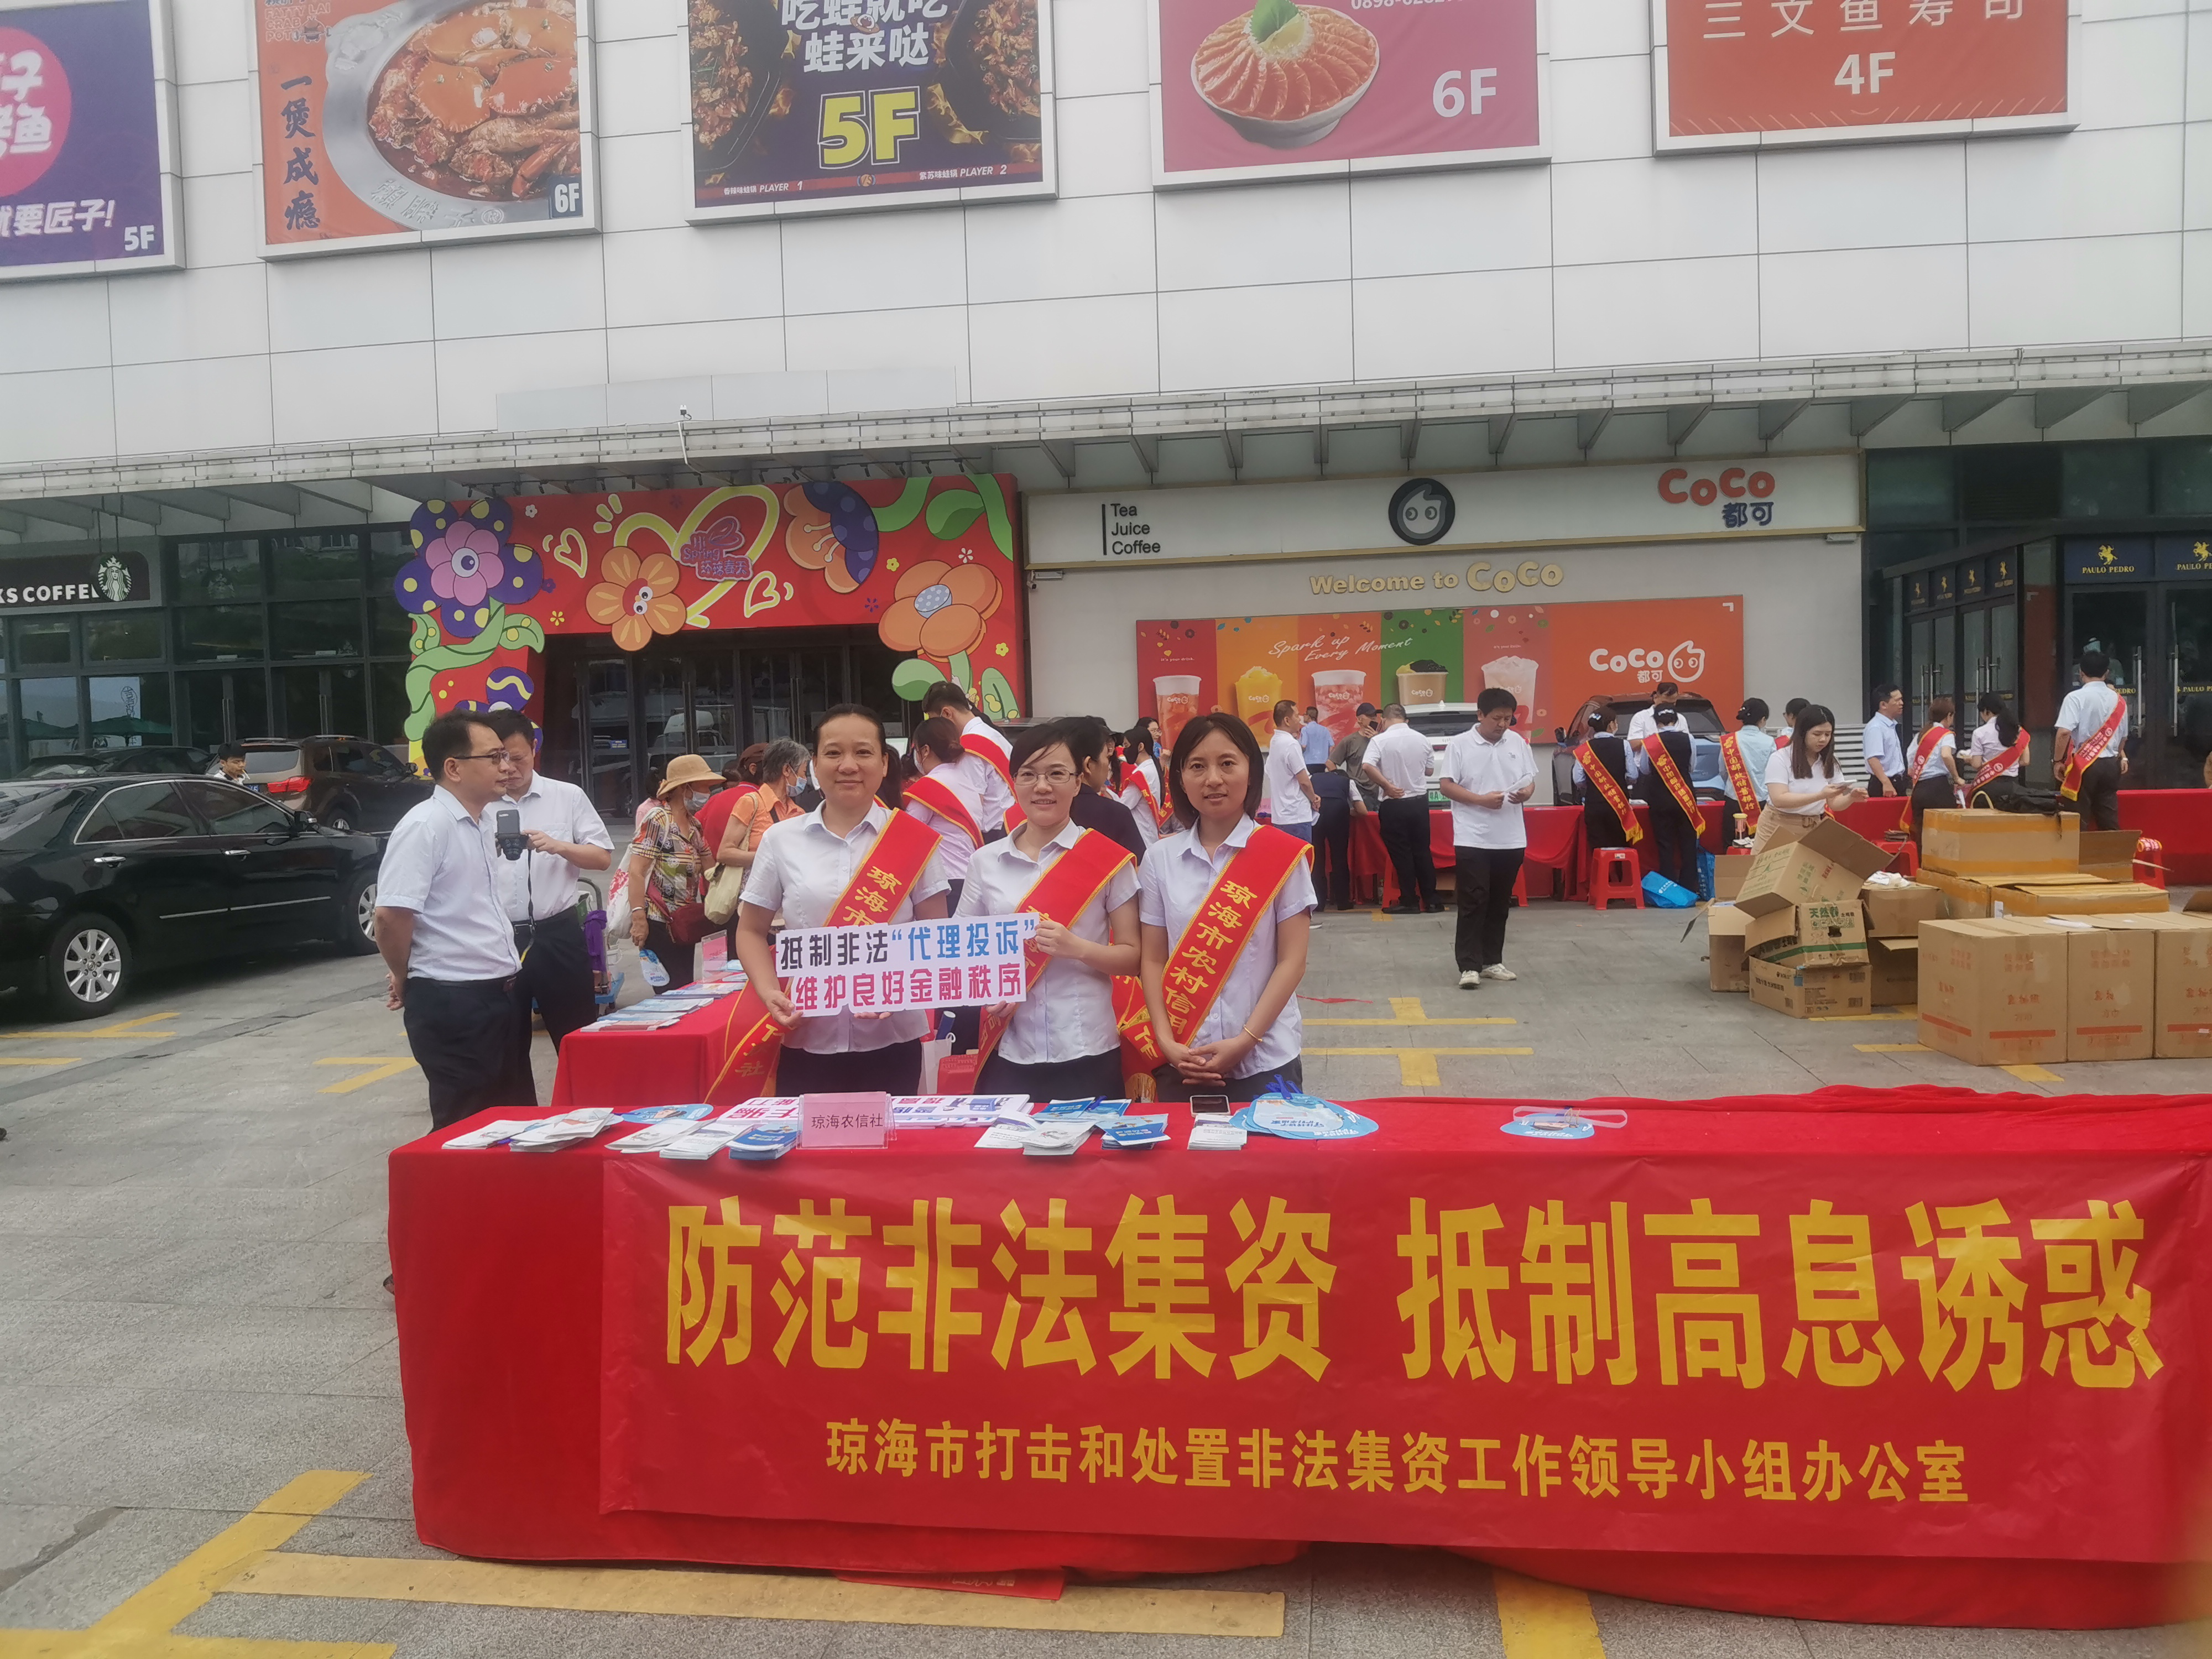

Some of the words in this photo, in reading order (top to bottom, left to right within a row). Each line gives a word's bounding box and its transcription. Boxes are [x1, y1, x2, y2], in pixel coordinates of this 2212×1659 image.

[265, 4, 305, 19] FATTY
[309, 2, 330, 14] LAI
[266, 17, 301, 30] CRAB
[804, 22, 928, 72] 蛙来哒
[1835, 51, 1896, 94] 4F
[1433, 67, 1498, 118] 6F
[817, 86, 920, 169] 5F
[281, 75, 321, 231] 一煲成瘾
[959, 166, 993, 177] PLAYER
[999, 164, 1007, 175] 2
[554, 184, 580, 212] 6F
[759, 182, 789, 193] PLAYER
[796, 180, 804, 191] 1
[124, 225, 155, 251] 5F
[1658, 468, 1776, 507] CoCo
[1111, 503, 1138, 518] Tea
[1721, 502, 1774, 529] 都可
[1111, 521, 1150, 536] Juice
[684, 547, 720, 561] Spring
[1112, 539, 1161, 555] Coffee
[1310, 573, 1425, 595] Welcome
[1432, 571, 1459, 590] to
[1466, 561, 1564, 593] CoCo
[1268, 635, 1326, 659] Spark
[1331, 636, 1351, 650] up
[1304, 648, 1349, 661] Every
[1355, 637, 1413, 655] Moment
[1589, 648, 1663, 672] CoCo
[1637, 670, 1663, 684] 都可
[795, 962, 1022, 1013] 维护良好金融秩序
[811, 1112, 884, 1130] 琼海农信社
[667, 1194, 1337, 1382] 防范非法集资
[1396, 1198, 2164, 1391] 抵制高息诱惑
[826, 1418, 1968, 1501] 琼海市打击和处置非法集资工作领导小组办公室
